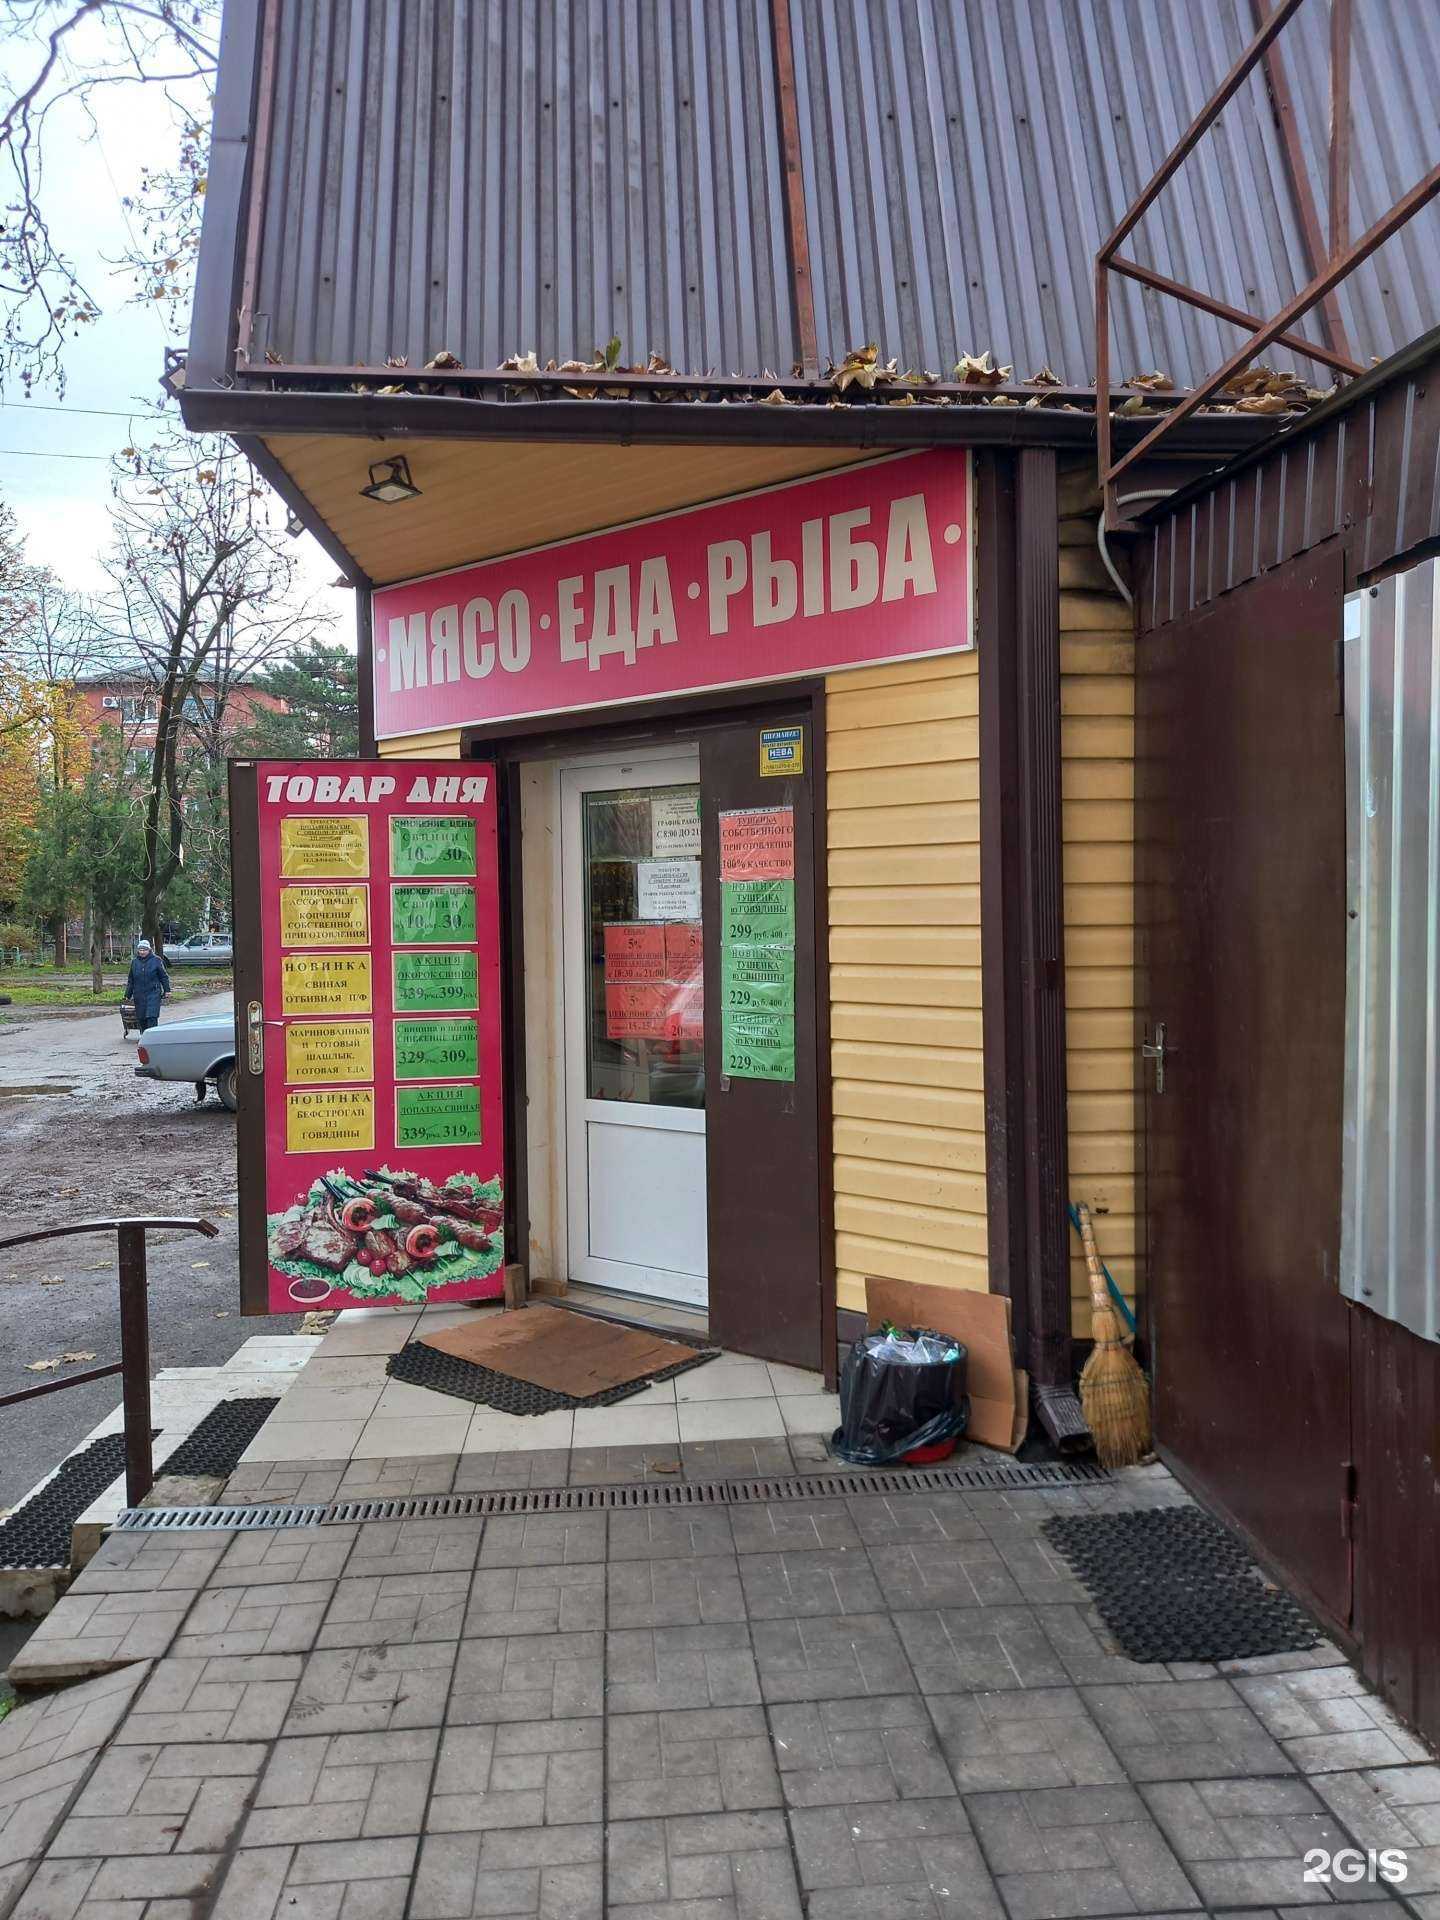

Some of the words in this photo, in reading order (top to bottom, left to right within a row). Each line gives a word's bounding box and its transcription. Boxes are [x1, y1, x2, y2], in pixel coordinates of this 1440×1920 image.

[387, 588, 532, 693] МЯСО
[557, 555, 679, 672] ЕДА
[706, 492, 938, 637] РЫБА
[265, 775, 396, 804] ТОВАР
[405, 776, 489, 804] ДНЯ
[722, 825, 793, 838] СОБСТВЕННОГО
[747, 859, 792, 869] КАЧЕСТВО
[300, 888, 349, 896] ШИРОКИЙ
[299, 911, 351, 920] КОПЧЕНИЯ
[287, 921, 362, 930] СОБСТВЕННОГО
[729, 924, 752, 938] 299
[284, 930, 366, 939] ПРИГОТОВЛЕНИЯ
[285, 961, 367, 972] НОВИНКА
[305, 980, 348, 989] СВИНАЯ
[439, 986, 464, 999] 399
[729, 990, 751, 1005] 229
[285, 994, 342, 1004] ОТБИВНАЯ
[349, 993, 368, 1002] П/Ф
[289, 1026, 370, 1037] МАРИНОВАННЫЙ
[315, 1039, 360, 1049] ГОТОВЫЙ
[398, 1050, 425, 1065] 329
[440, 1049, 466, 1063] 309
[730, 1054, 752, 1070] 229
[296, 1066, 339, 1075] ГОТОВАЯ
[346, 1066, 366, 1074] ЕДА
[290, 1092, 372, 1105] НОВИНКА
[417, 1089, 464, 1100] АКЦИЯ
[297, 1108, 365, 1119] БЕФСТРОГАН
[400, 1105, 443, 1115] ЛОПАТКА
[325, 1120, 337, 1128] ИЗ
[302, 1129, 360, 1140] ГОВЯДИНЫ
[402, 1126, 426, 1141] 339
[442, 1124, 467, 1138] 319
